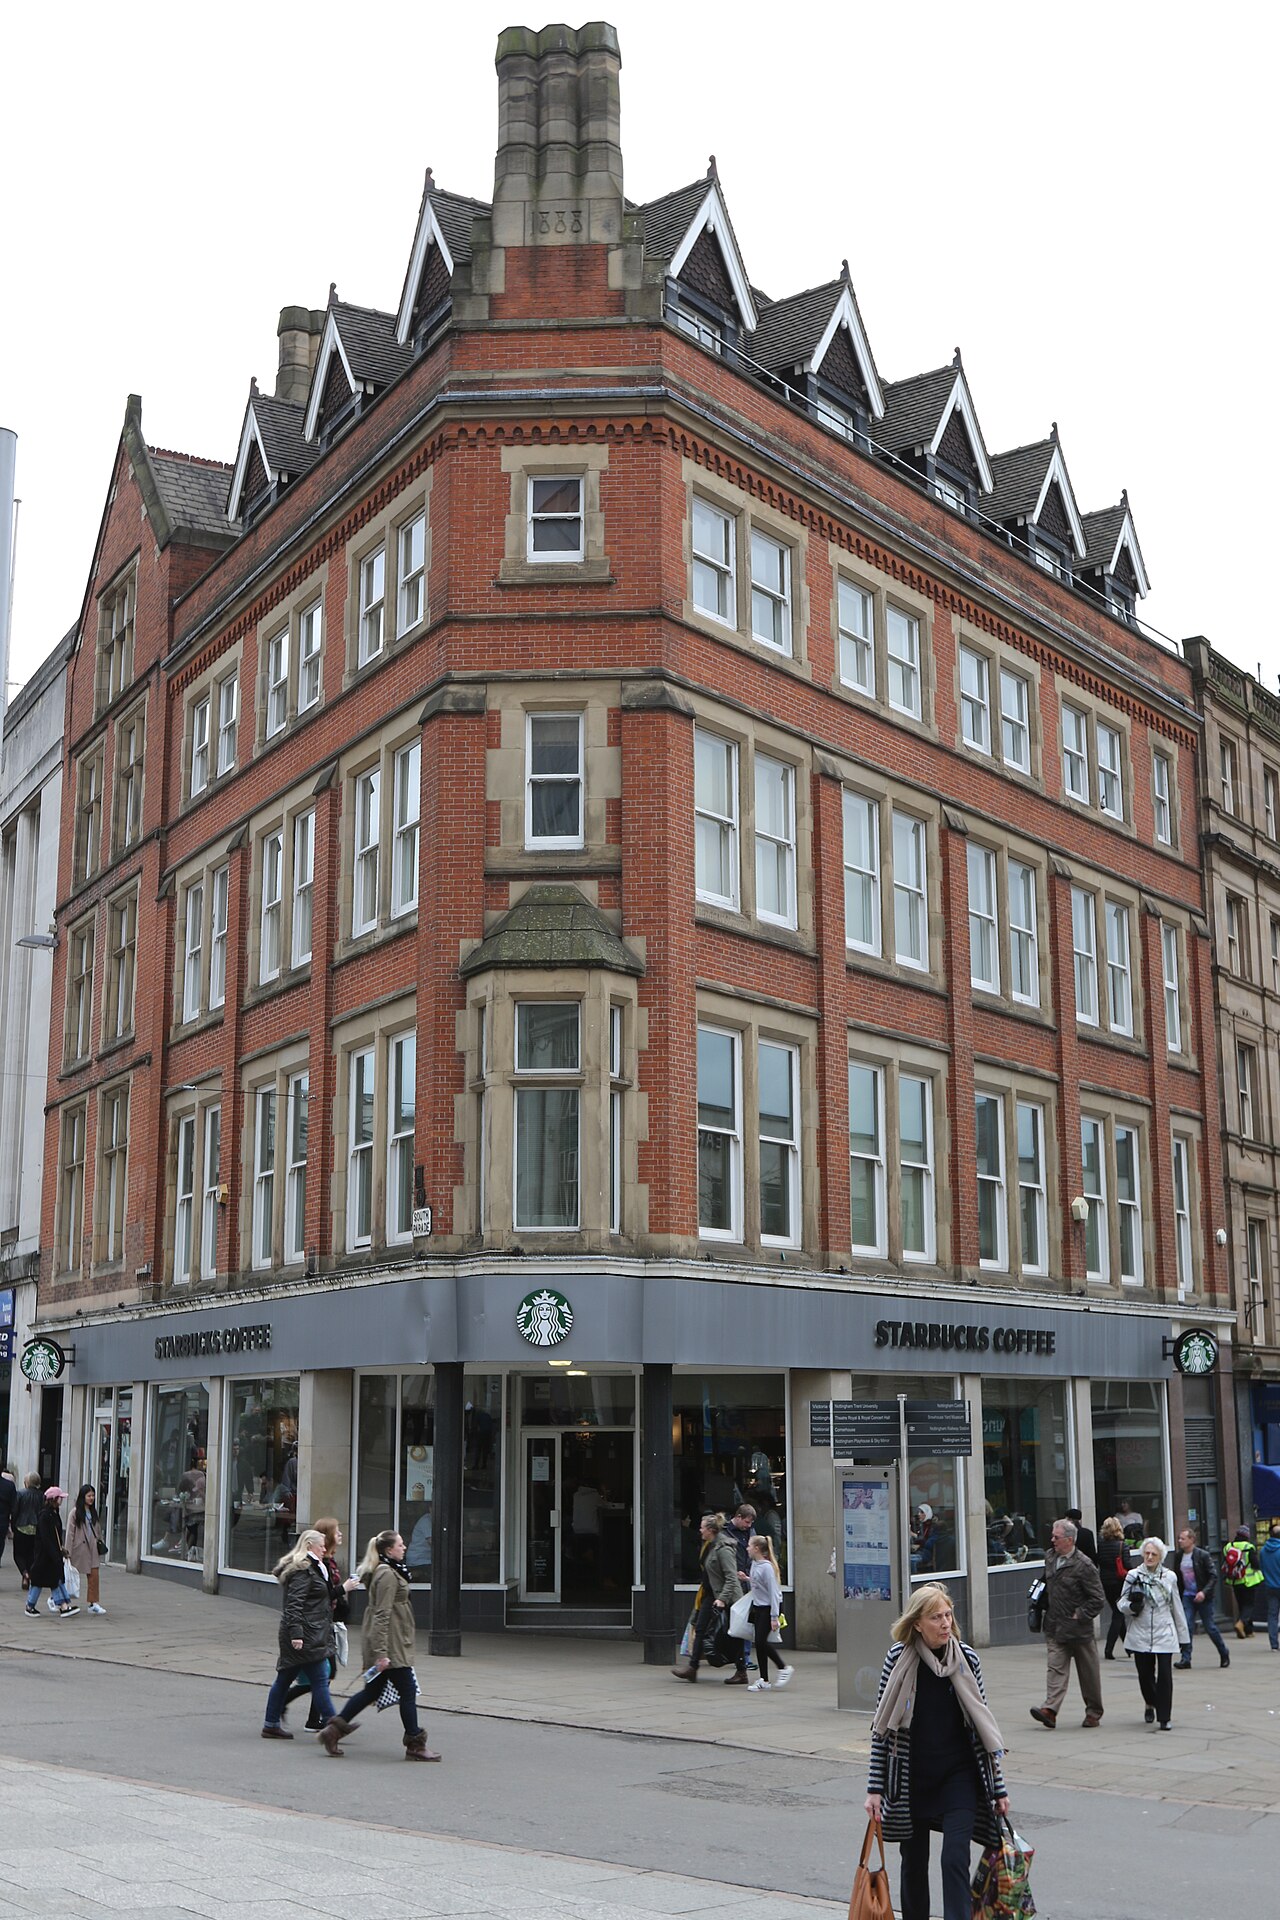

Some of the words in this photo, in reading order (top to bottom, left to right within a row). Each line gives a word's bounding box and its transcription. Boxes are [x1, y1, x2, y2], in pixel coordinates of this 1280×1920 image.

[413, 1211, 430, 1222] SOUTH
[413, 1222, 430, 1234] PARADE
[155, 1329, 222, 1359] STARBUCKS
[222, 1323, 272, 1354] COFFEE
[875, 1320, 989, 1351] STARBUCKS
[993, 1327, 1056, 1354] COFFEE
